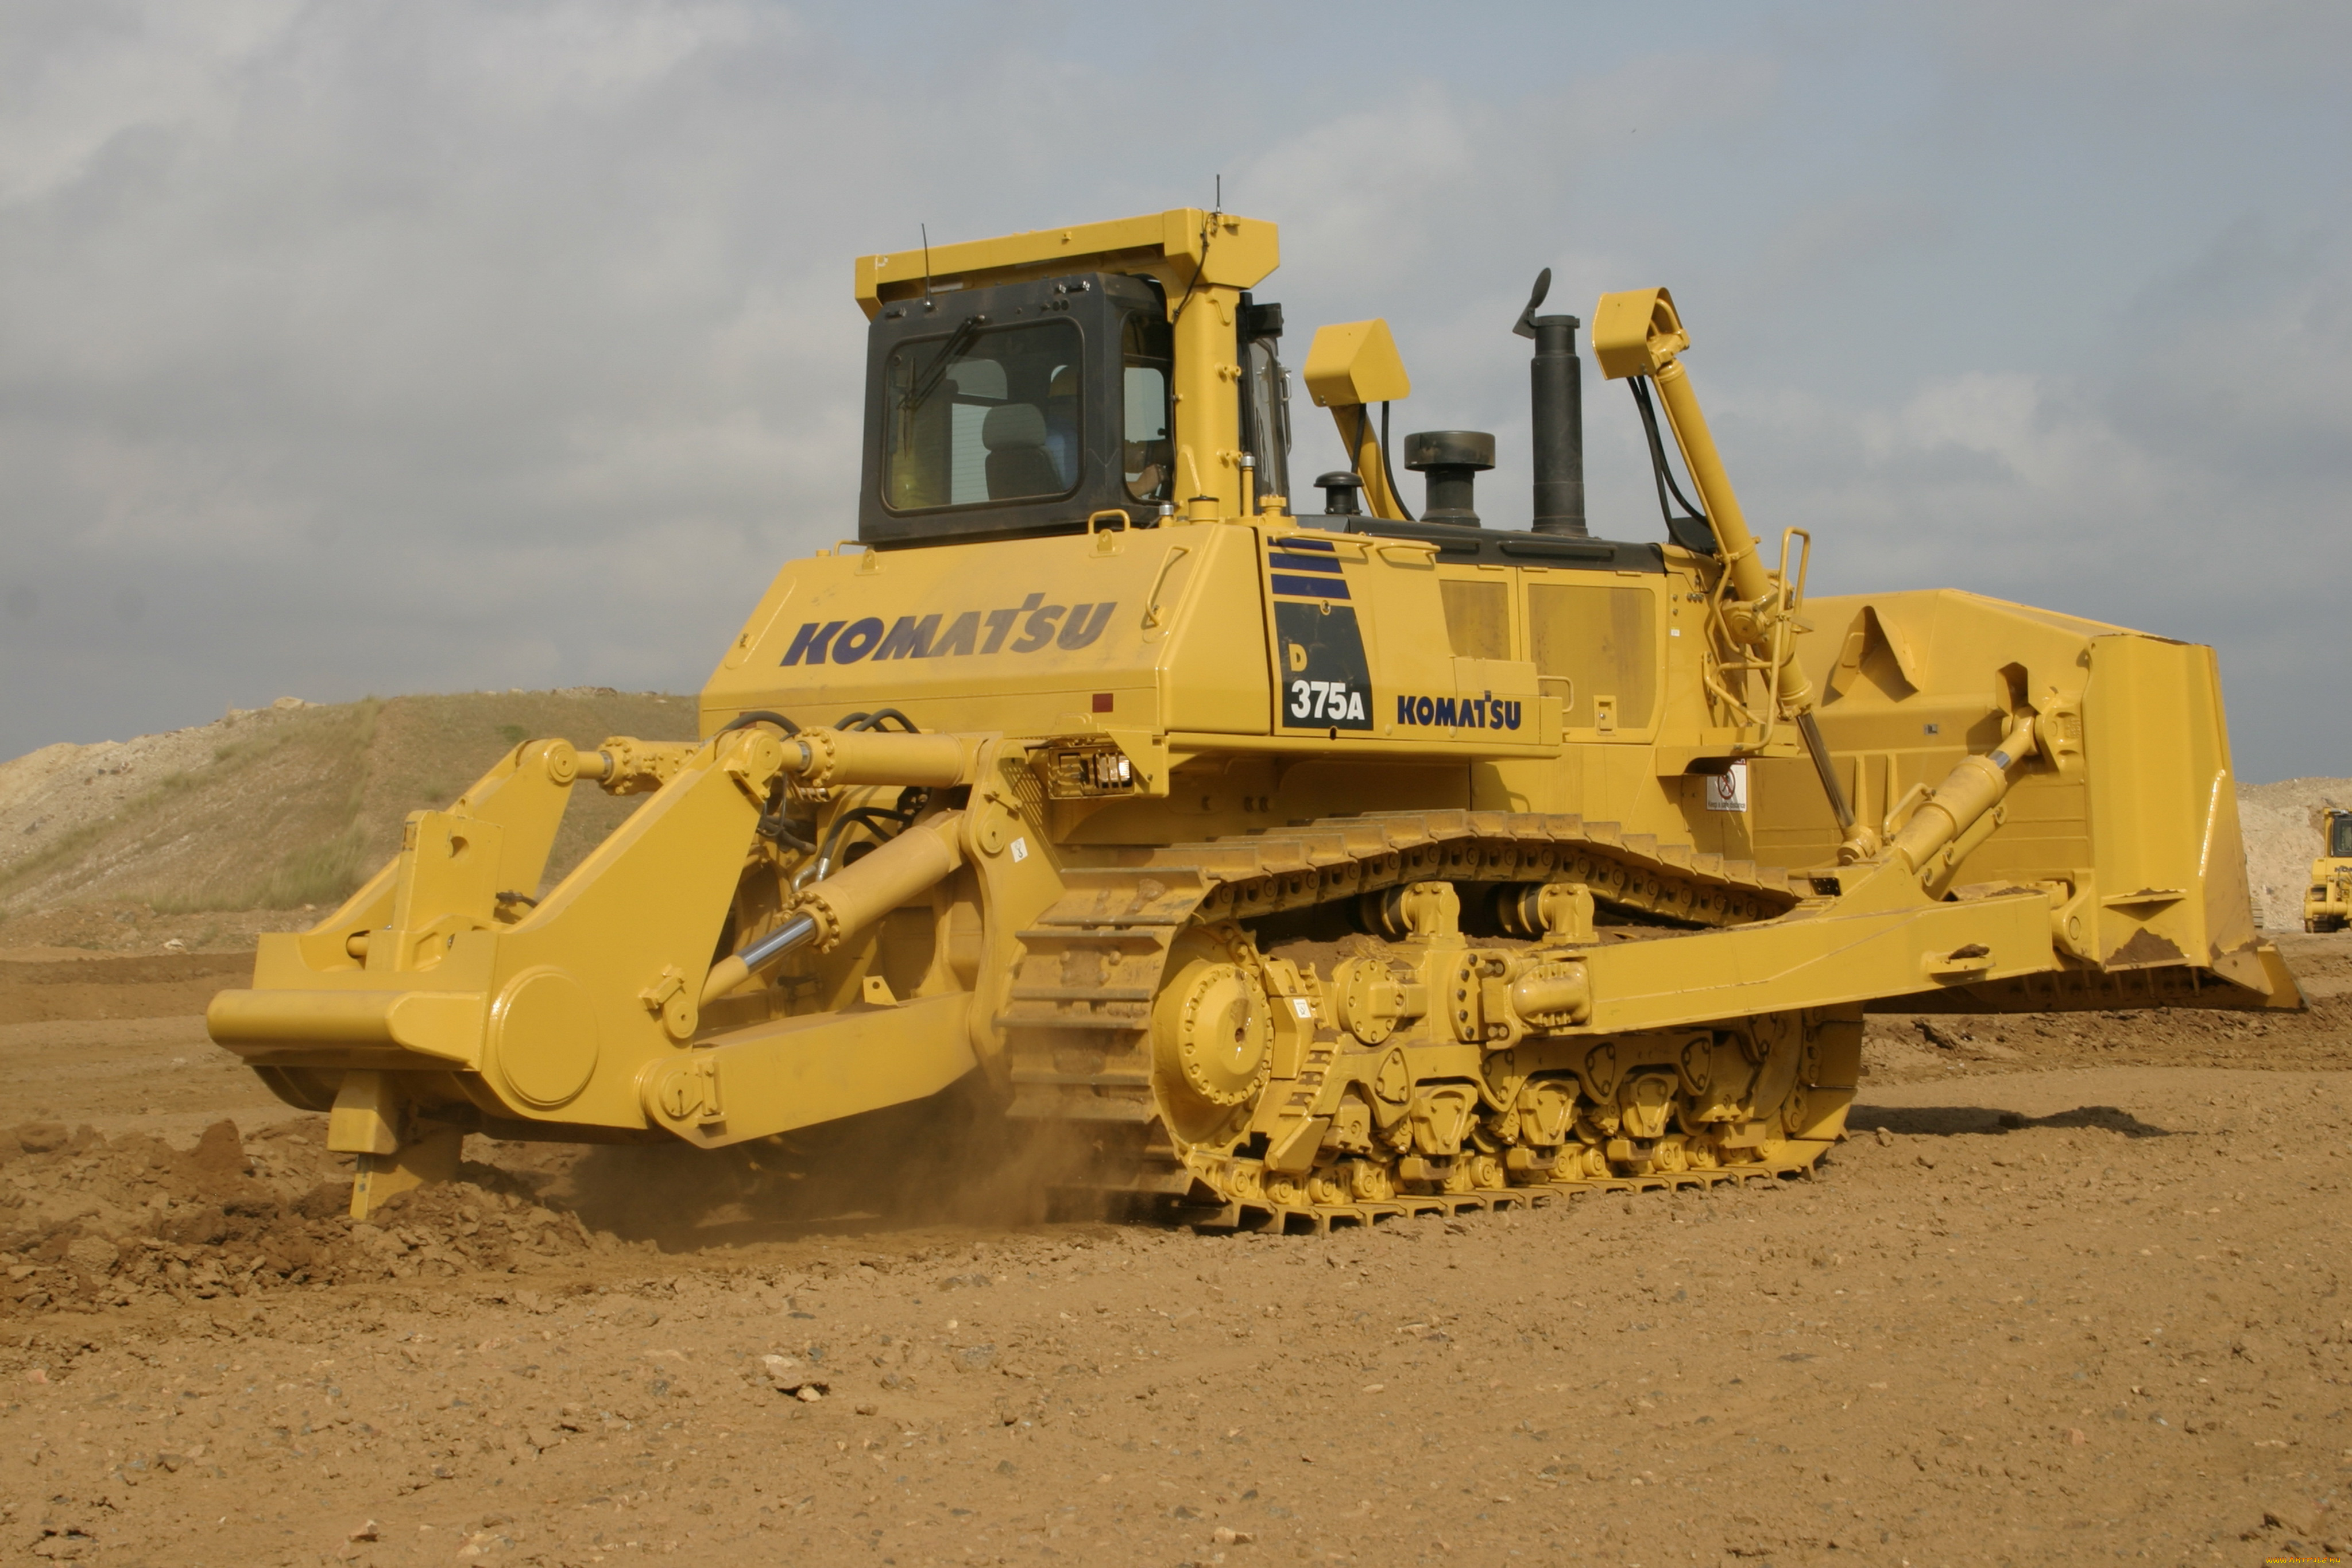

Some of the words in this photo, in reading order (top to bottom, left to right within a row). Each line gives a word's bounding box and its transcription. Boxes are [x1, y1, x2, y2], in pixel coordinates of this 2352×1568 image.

[779, 592, 1118, 667] KOMATSU
[1288, 643, 1308, 672] D
[1290, 679, 1365, 721] 375A
[1397, 690, 1522, 730] KOMATSU
